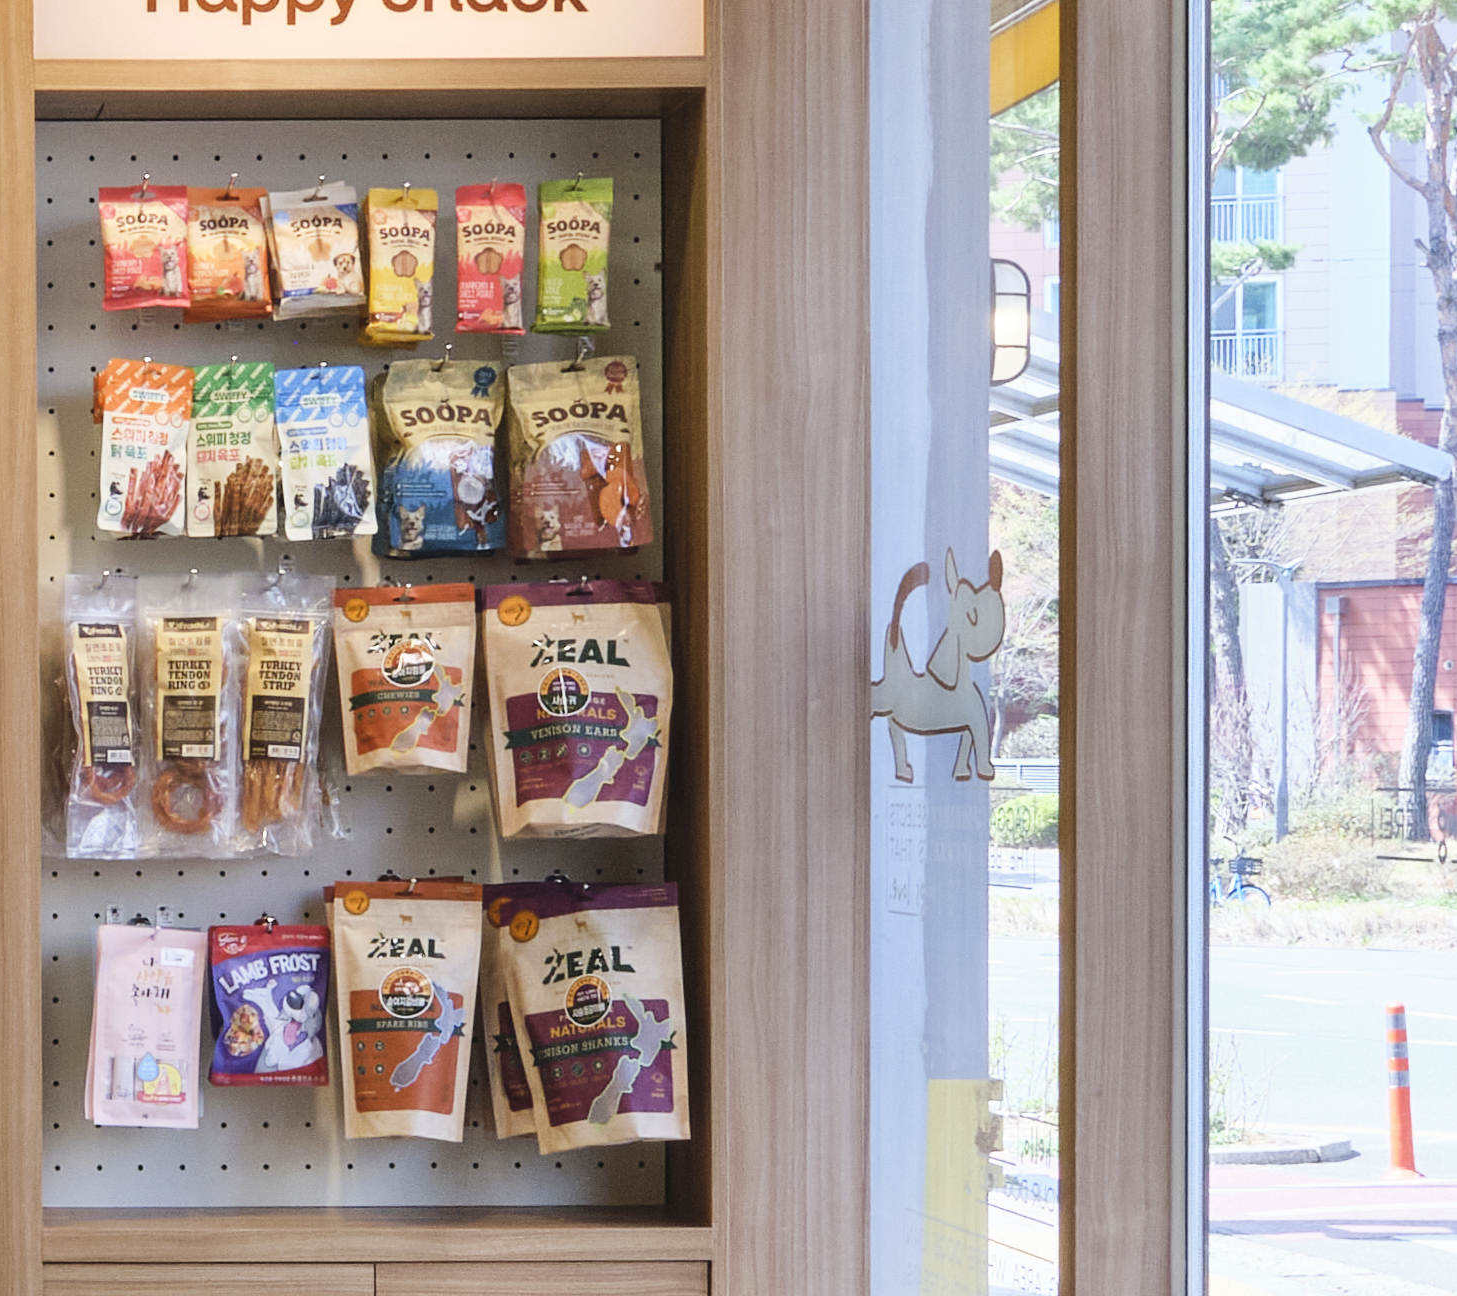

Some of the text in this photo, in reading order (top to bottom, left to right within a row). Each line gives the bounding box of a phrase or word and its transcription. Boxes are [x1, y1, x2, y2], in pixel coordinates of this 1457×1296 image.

[196, 432, 227, 448] 스위피
[530, 634, 631, 667] ZEAL
[168, 660, 212, 670] TURKEY
[259, 660, 302, 671] TURKEY
[168, 670, 211, 680] TENDON
[259, 671, 301, 681] TENDON
[90, 686, 114, 695] RING
[168, 680, 195, 690] RING
[262, 681, 296, 691] STRIP
[531, 723, 619, 739] VENISON EARS
[367, 932, 446, 959] ZEAL
[542, 946, 636, 985] ZEAL
[218, 953, 322, 995] LAMB FROST
[583, 1037, 630, 1052] SHANKS
